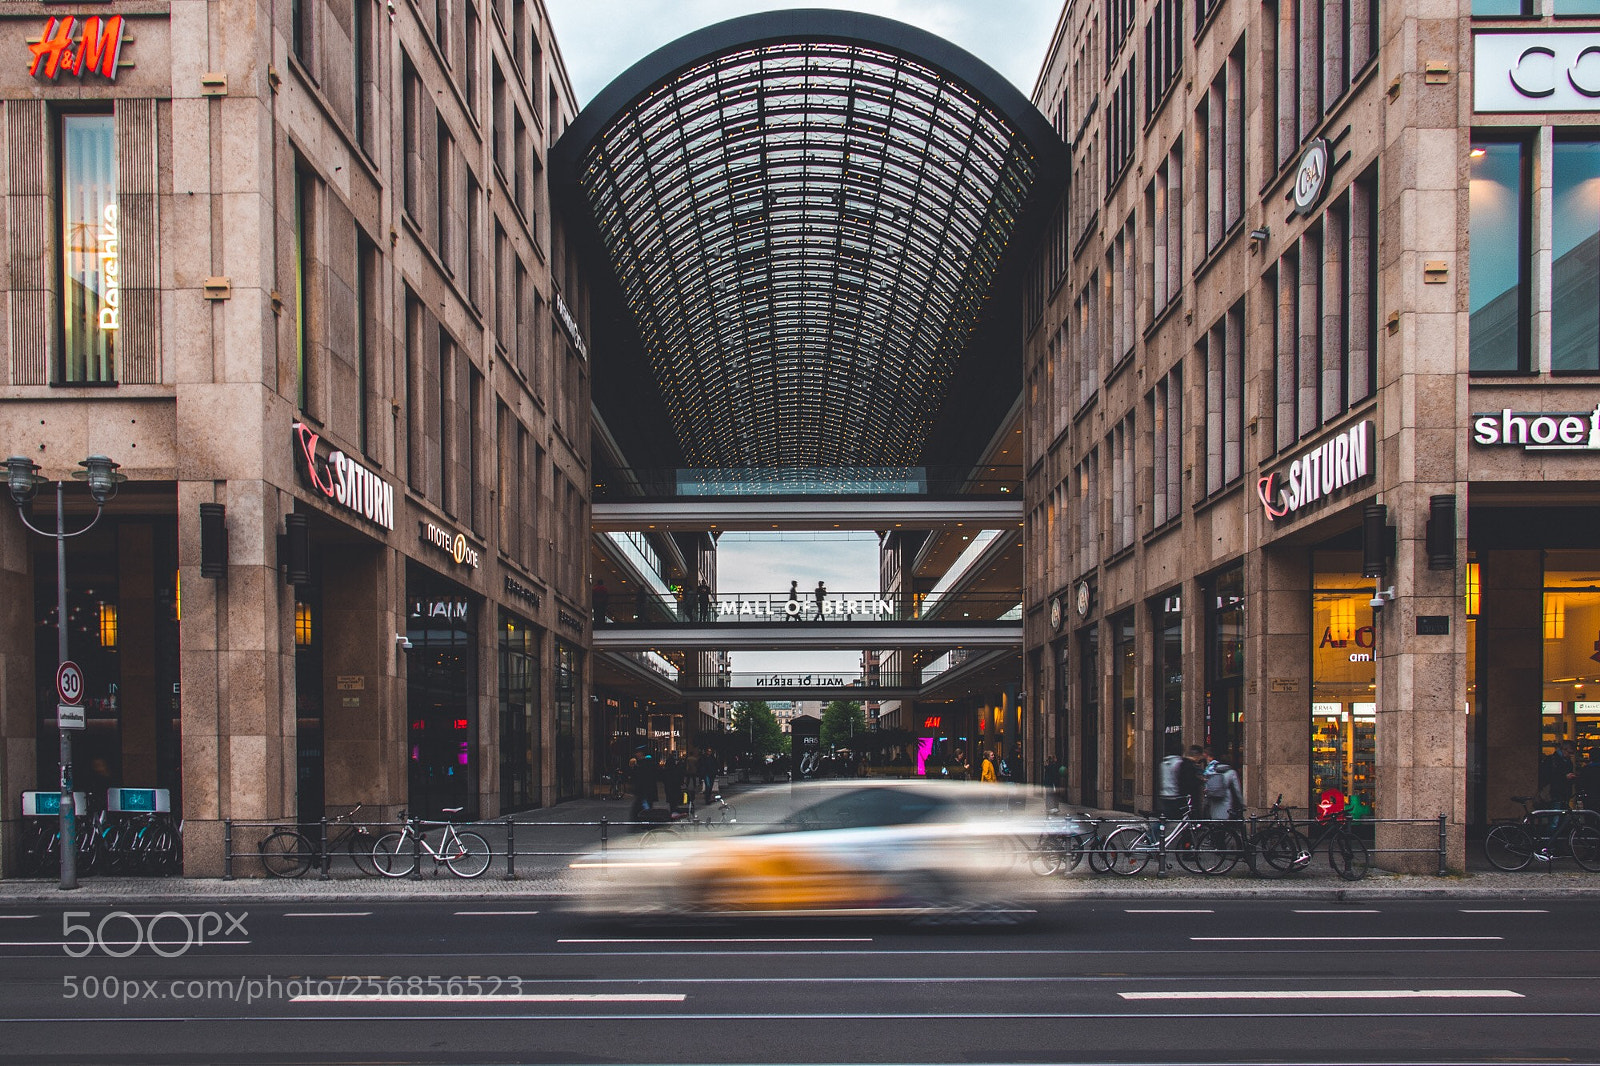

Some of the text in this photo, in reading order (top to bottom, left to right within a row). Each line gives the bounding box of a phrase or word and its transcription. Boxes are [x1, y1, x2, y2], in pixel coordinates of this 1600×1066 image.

[29, 15, 124, 80] H&M
[1299, 155, 1321, 196] C&A
[99, 204, 119, 329] Bershka
[1289, 420, 1368, 511] SATURN
[331, 451, 394, 531] SATURN
[428, 523, 454, 554] MOTEL
[465, 546, 478, 568] ONE
[720, 599, 894, 615] MALL OF BERLIN
[1349, 653, 1369, 662] am
[63, 673, 79, 692] 30
